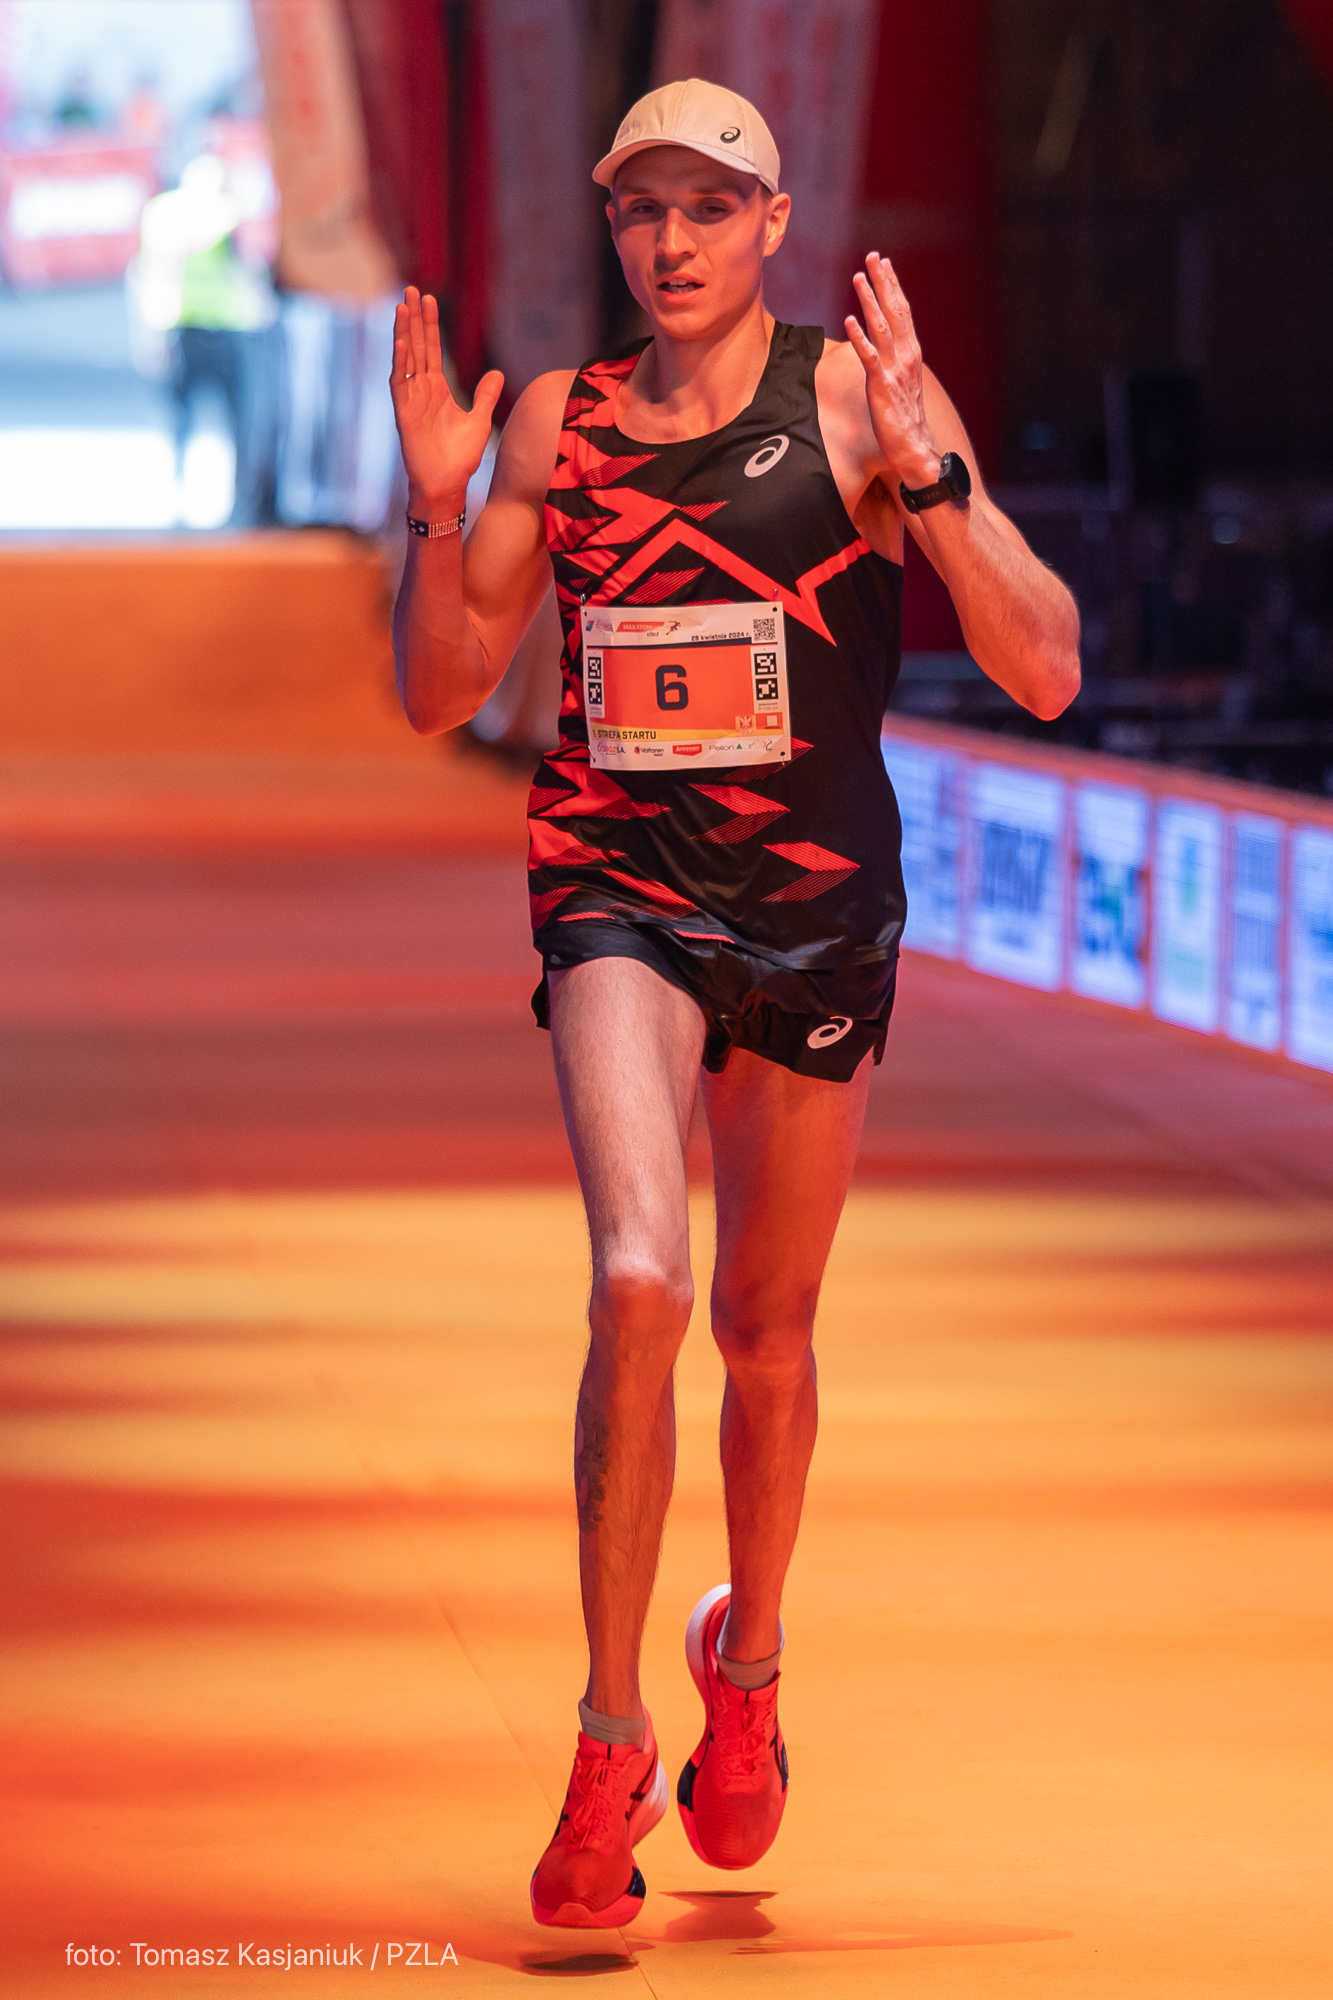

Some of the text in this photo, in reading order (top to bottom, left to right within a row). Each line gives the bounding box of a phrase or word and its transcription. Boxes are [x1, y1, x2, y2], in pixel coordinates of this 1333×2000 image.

[655, 664, 689, 711] 6
[598, 729, 620, 739] STREFA
[622, 731, 657, 740] STARTU
